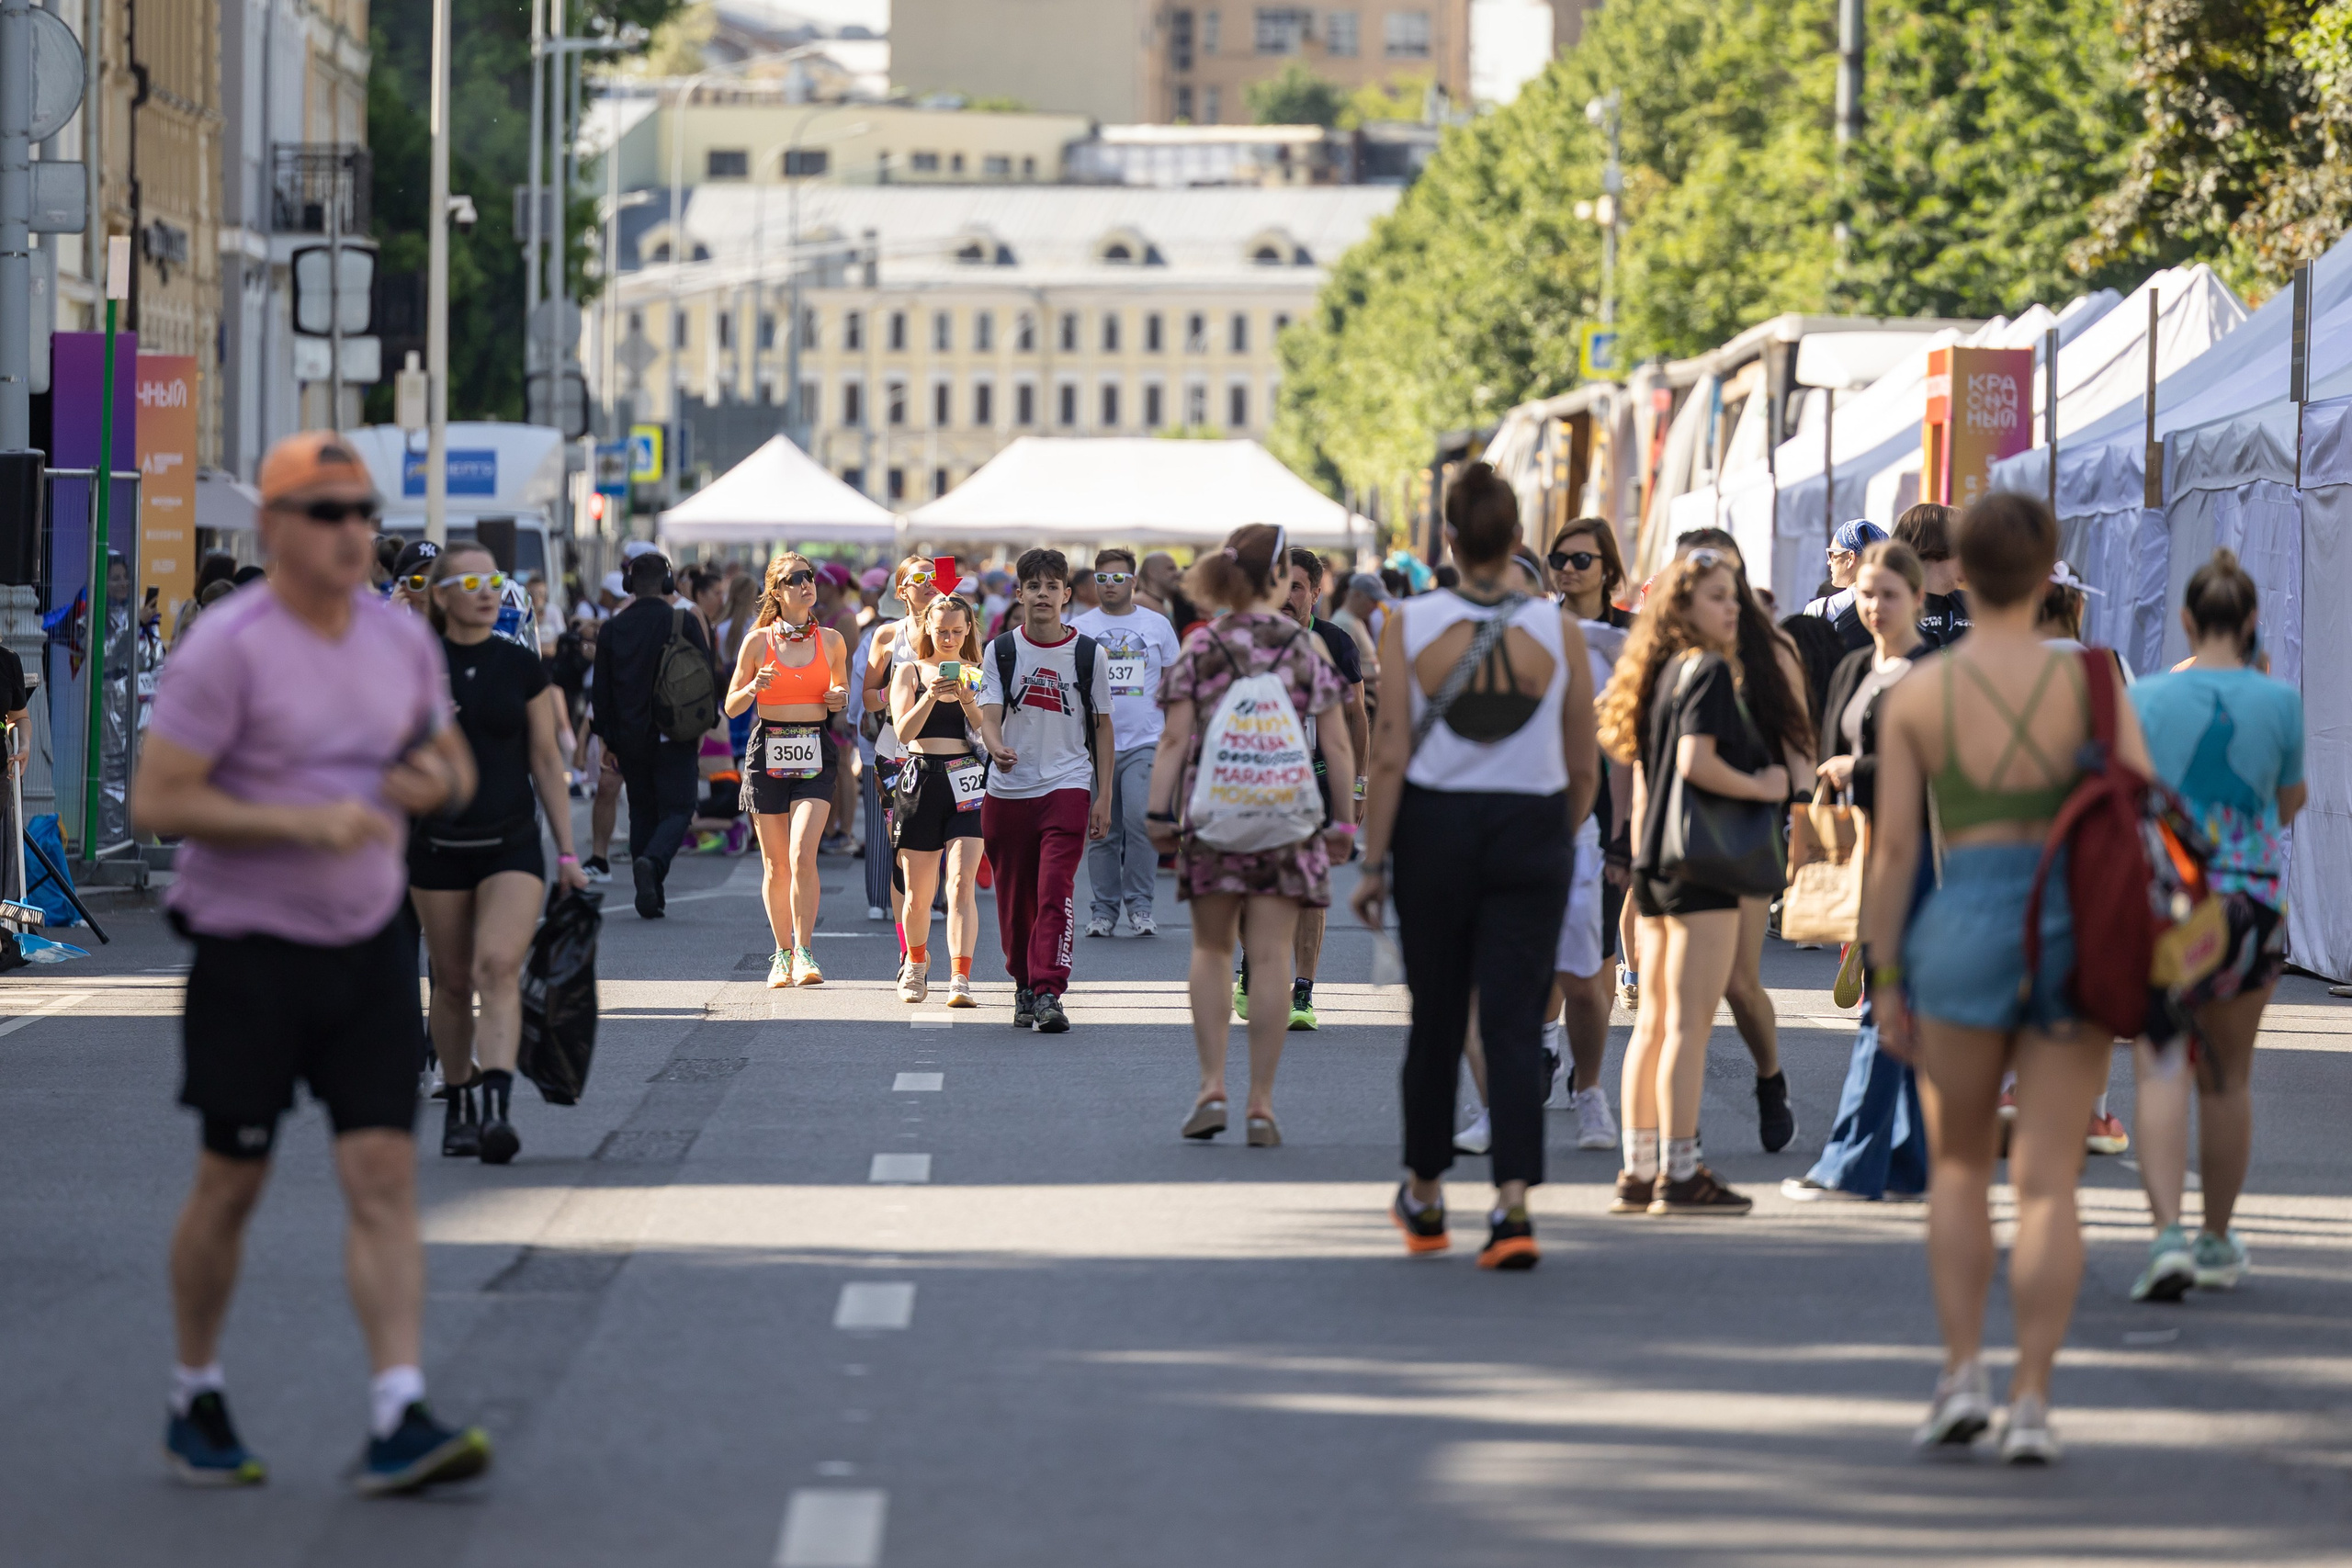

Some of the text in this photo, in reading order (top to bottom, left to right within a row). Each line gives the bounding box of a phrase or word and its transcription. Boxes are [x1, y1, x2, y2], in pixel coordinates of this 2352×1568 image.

[1967, 372, 2017, 392] КРА
[1966, 408, 2018, 428] НЫЙ
[1108, 666, 1133, 680] 637
[774, 745, 814, 761] 3506
[1212, 765, 1311, 785] MARATHON
[1209, 785, 1297, 806] MOSCOW
